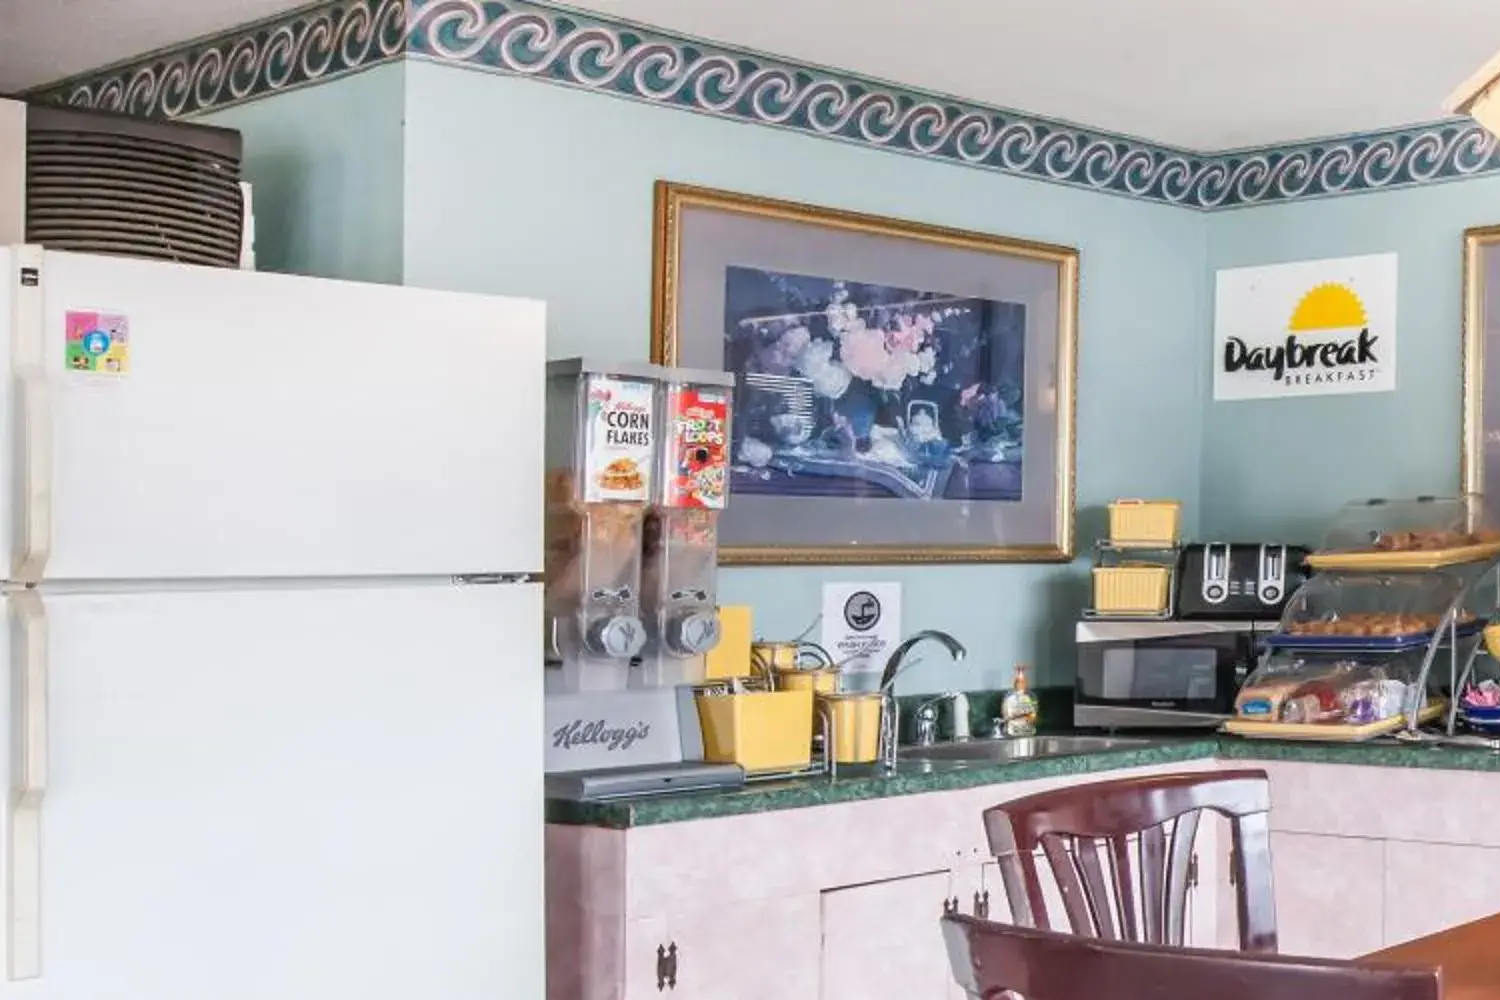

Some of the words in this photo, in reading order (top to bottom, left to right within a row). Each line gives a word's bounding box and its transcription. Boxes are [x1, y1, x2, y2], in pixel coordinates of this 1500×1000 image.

[1224, 328, 1379, 381] Daybreak
[1284, 369, 1376, 386] BREAKFAST
[607, 411, 649, 430] CORN
[606, 430, 650, 447] FLAKES
[553, 719, 651, 752] Kellogg's
